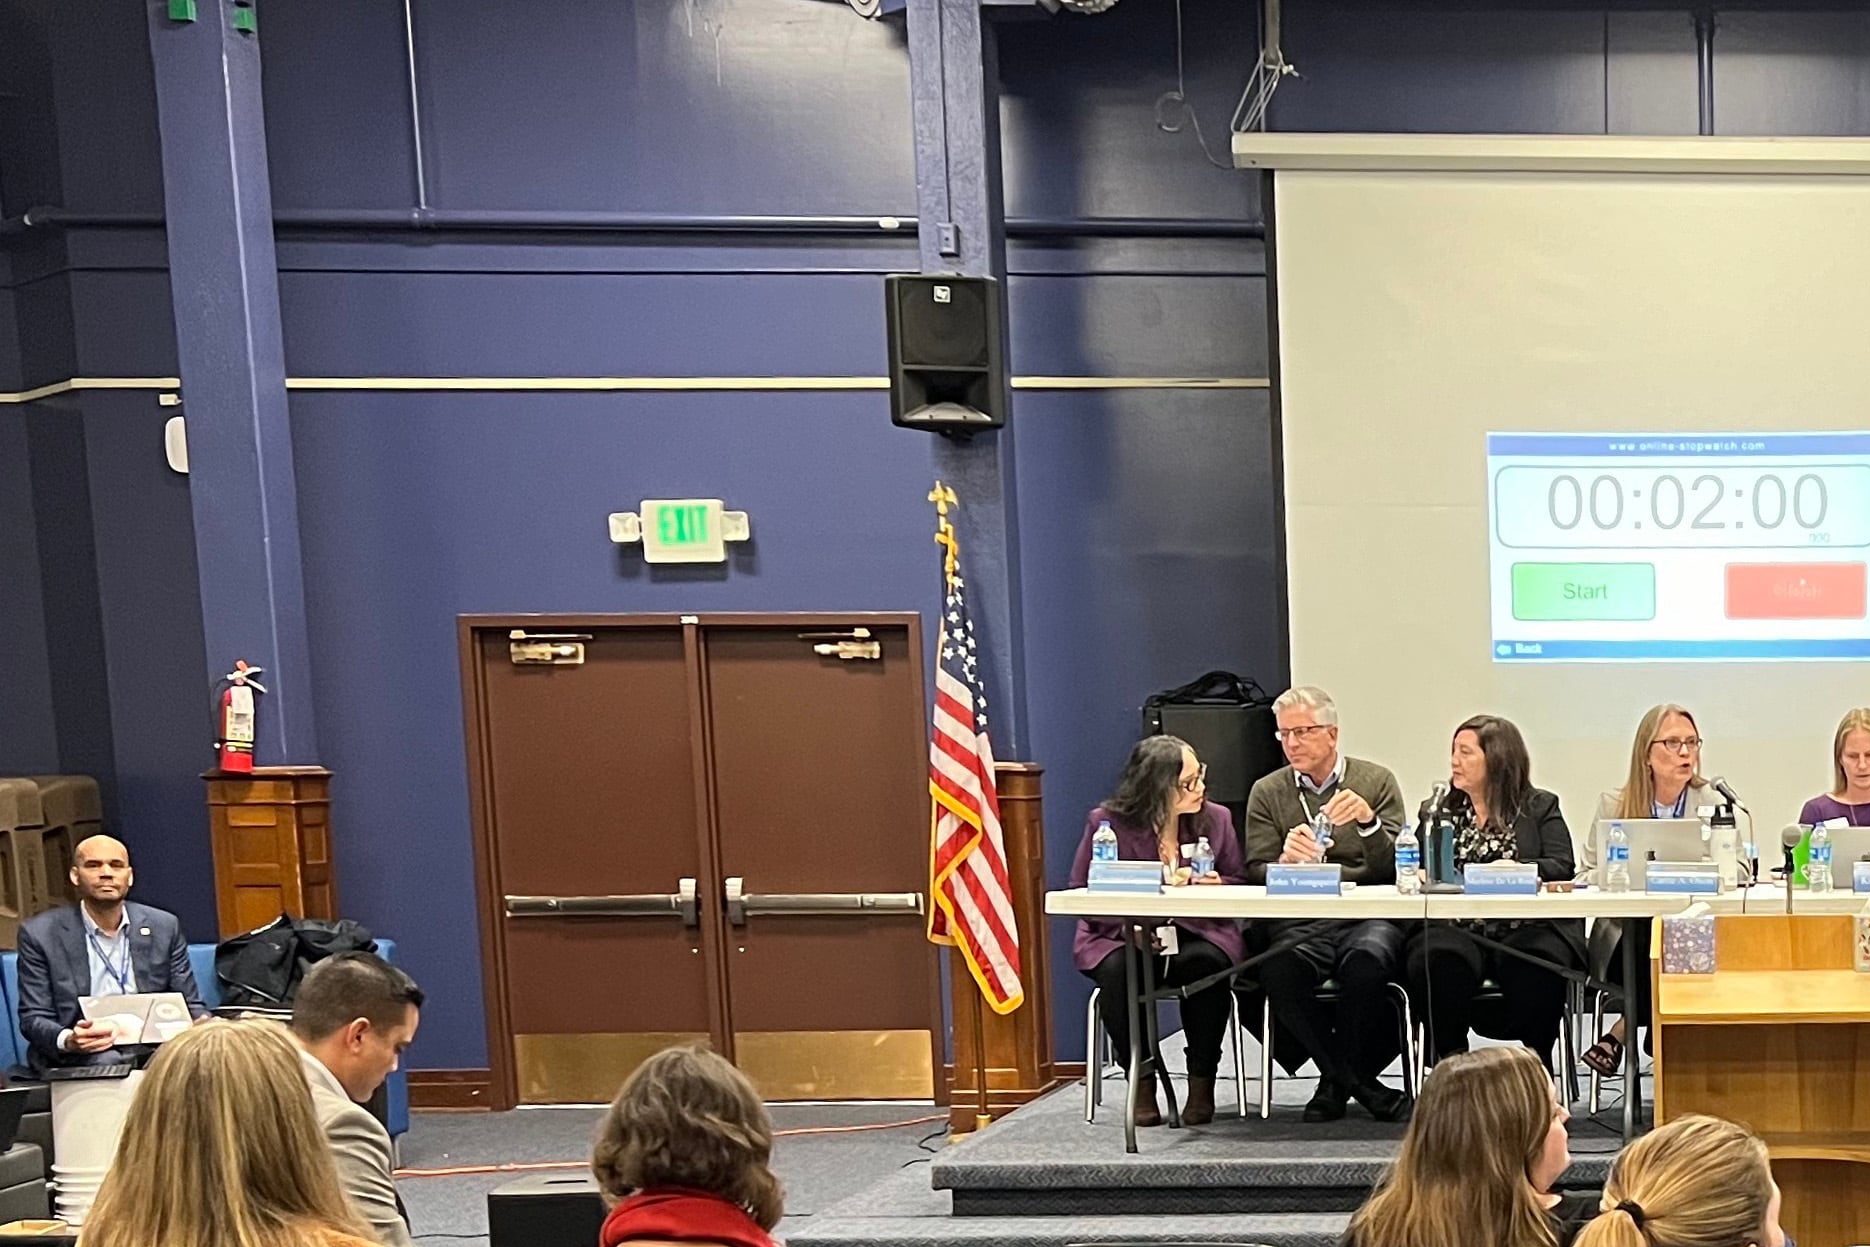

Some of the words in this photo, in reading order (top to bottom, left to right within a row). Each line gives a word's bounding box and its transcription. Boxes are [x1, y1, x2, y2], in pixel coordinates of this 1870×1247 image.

[1548, 474, 1828, 530] 00:02:00
[658, 505, 708, 545] EXIT
[1563, 582, 1608, 600] Start
[1516, 642, 1542, 654] Back
